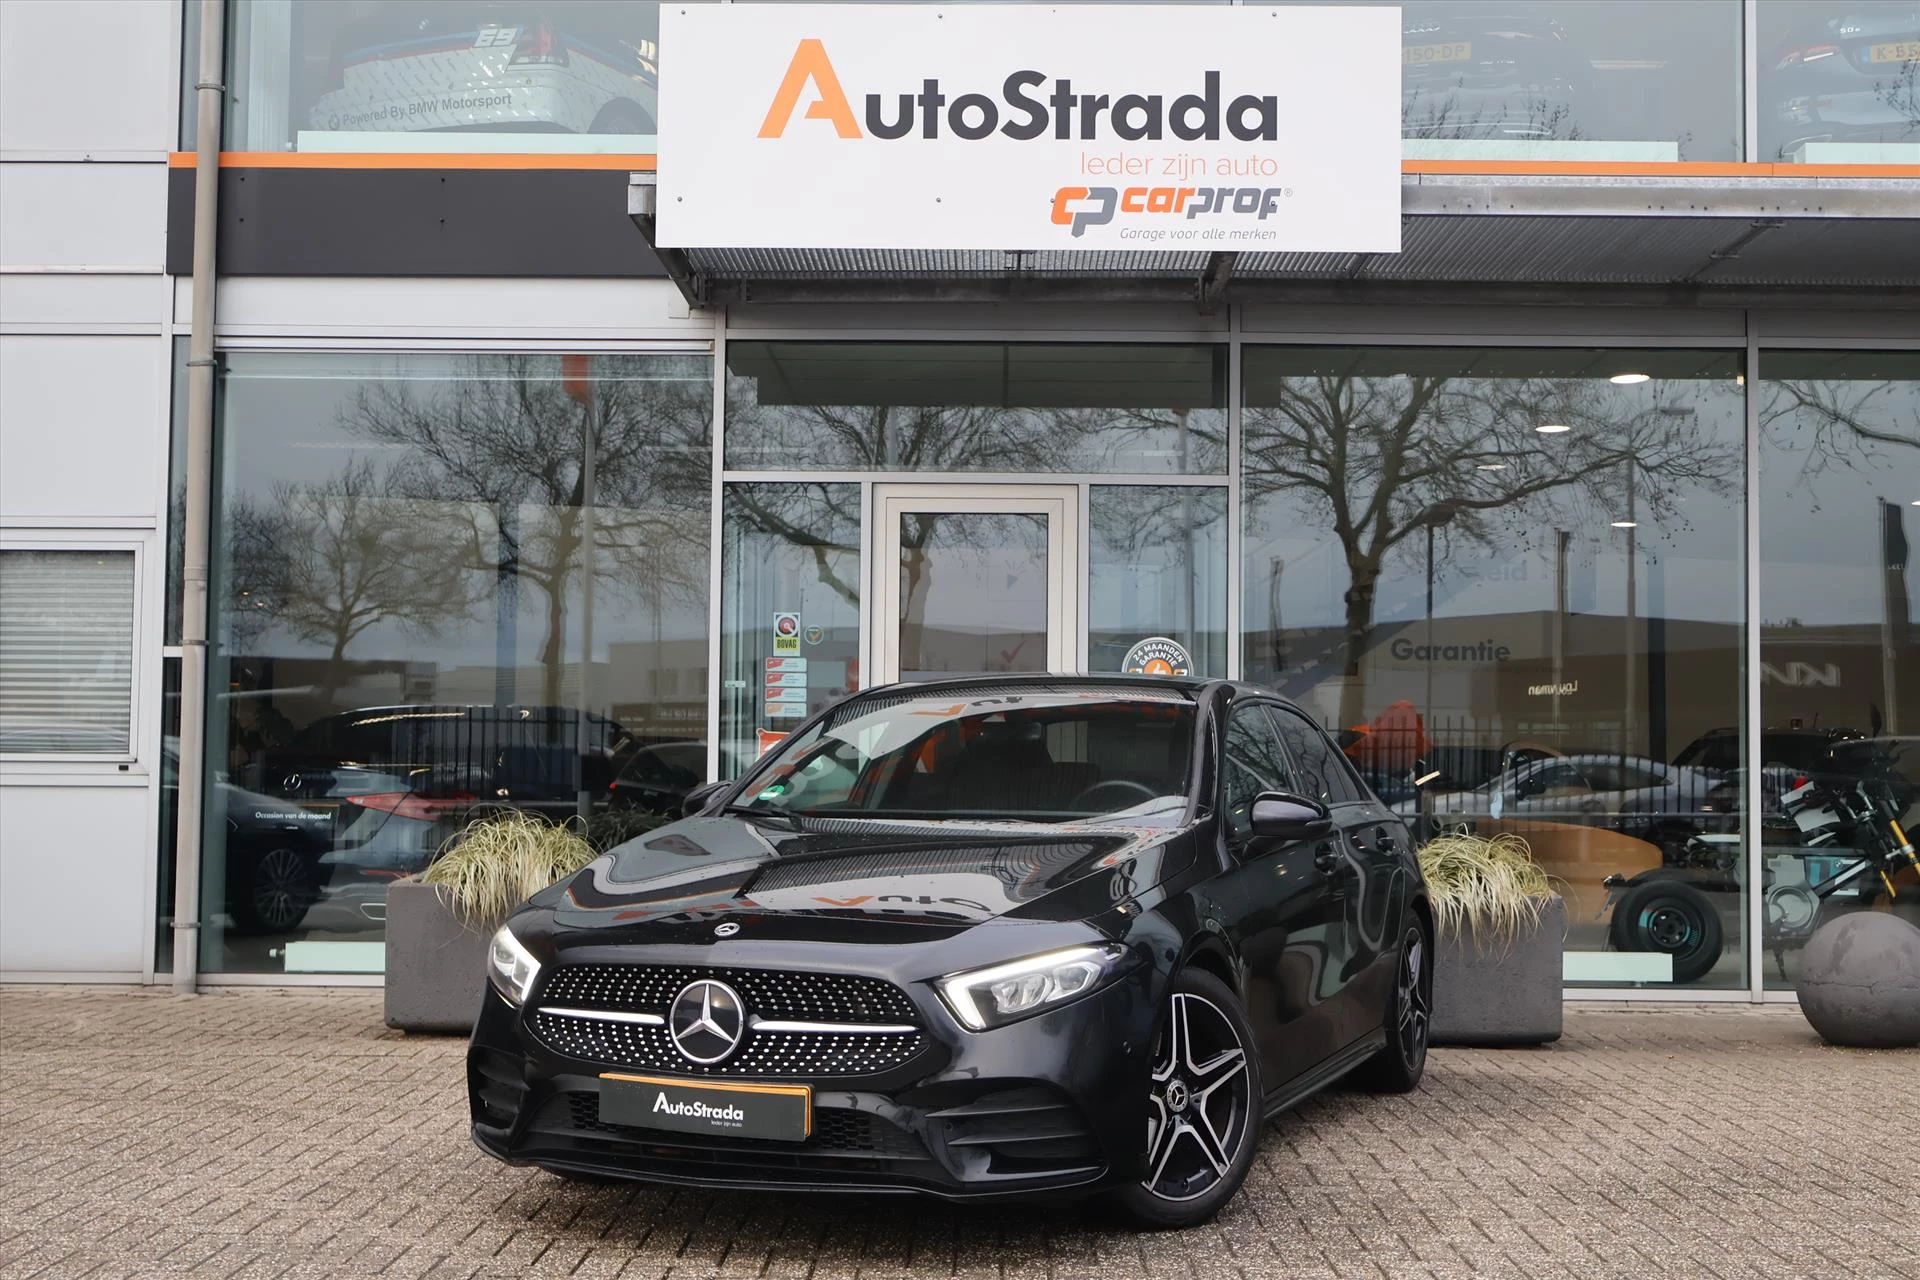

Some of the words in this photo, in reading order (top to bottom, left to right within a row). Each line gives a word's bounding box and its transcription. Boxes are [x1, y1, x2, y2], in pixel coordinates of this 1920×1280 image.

[756, 38, 1279, 142] AutoStrada
[342, 107, 387, 126] Powered
[389, 105, 405, 120] By
[408, 99, 438, 115] BMW
[441, 93, 512, 112] Motorsport
[1080, 151, 1154, 176] Ieder
[1162, 153, 1207, 181] zijn
[1215, 154, 1279, 176] auto
[1120, 186, 1282, 220] carprof
[1119, 227, 1165, 242] Garage
[1169, 229, 1199, 240] voor
[1201, 227, 1227, 240] alle
[1229, 227, 1277, 240] merken
[776, 638, 797, 649] BOVAG
[1132, 650, 1144, 662] 24
[1144, 643, 1184, 663] MAANDEN
[1390, 638, 1512, 662] Garantie
[1139, 651, 1178, 668] GARANTIE
[255, 811, 284, 820] Occasion
[297, 811, 307, 820] de
[307, 811, 332, 820] maand
[653, 1091, 744, 1121] AutoStrada
